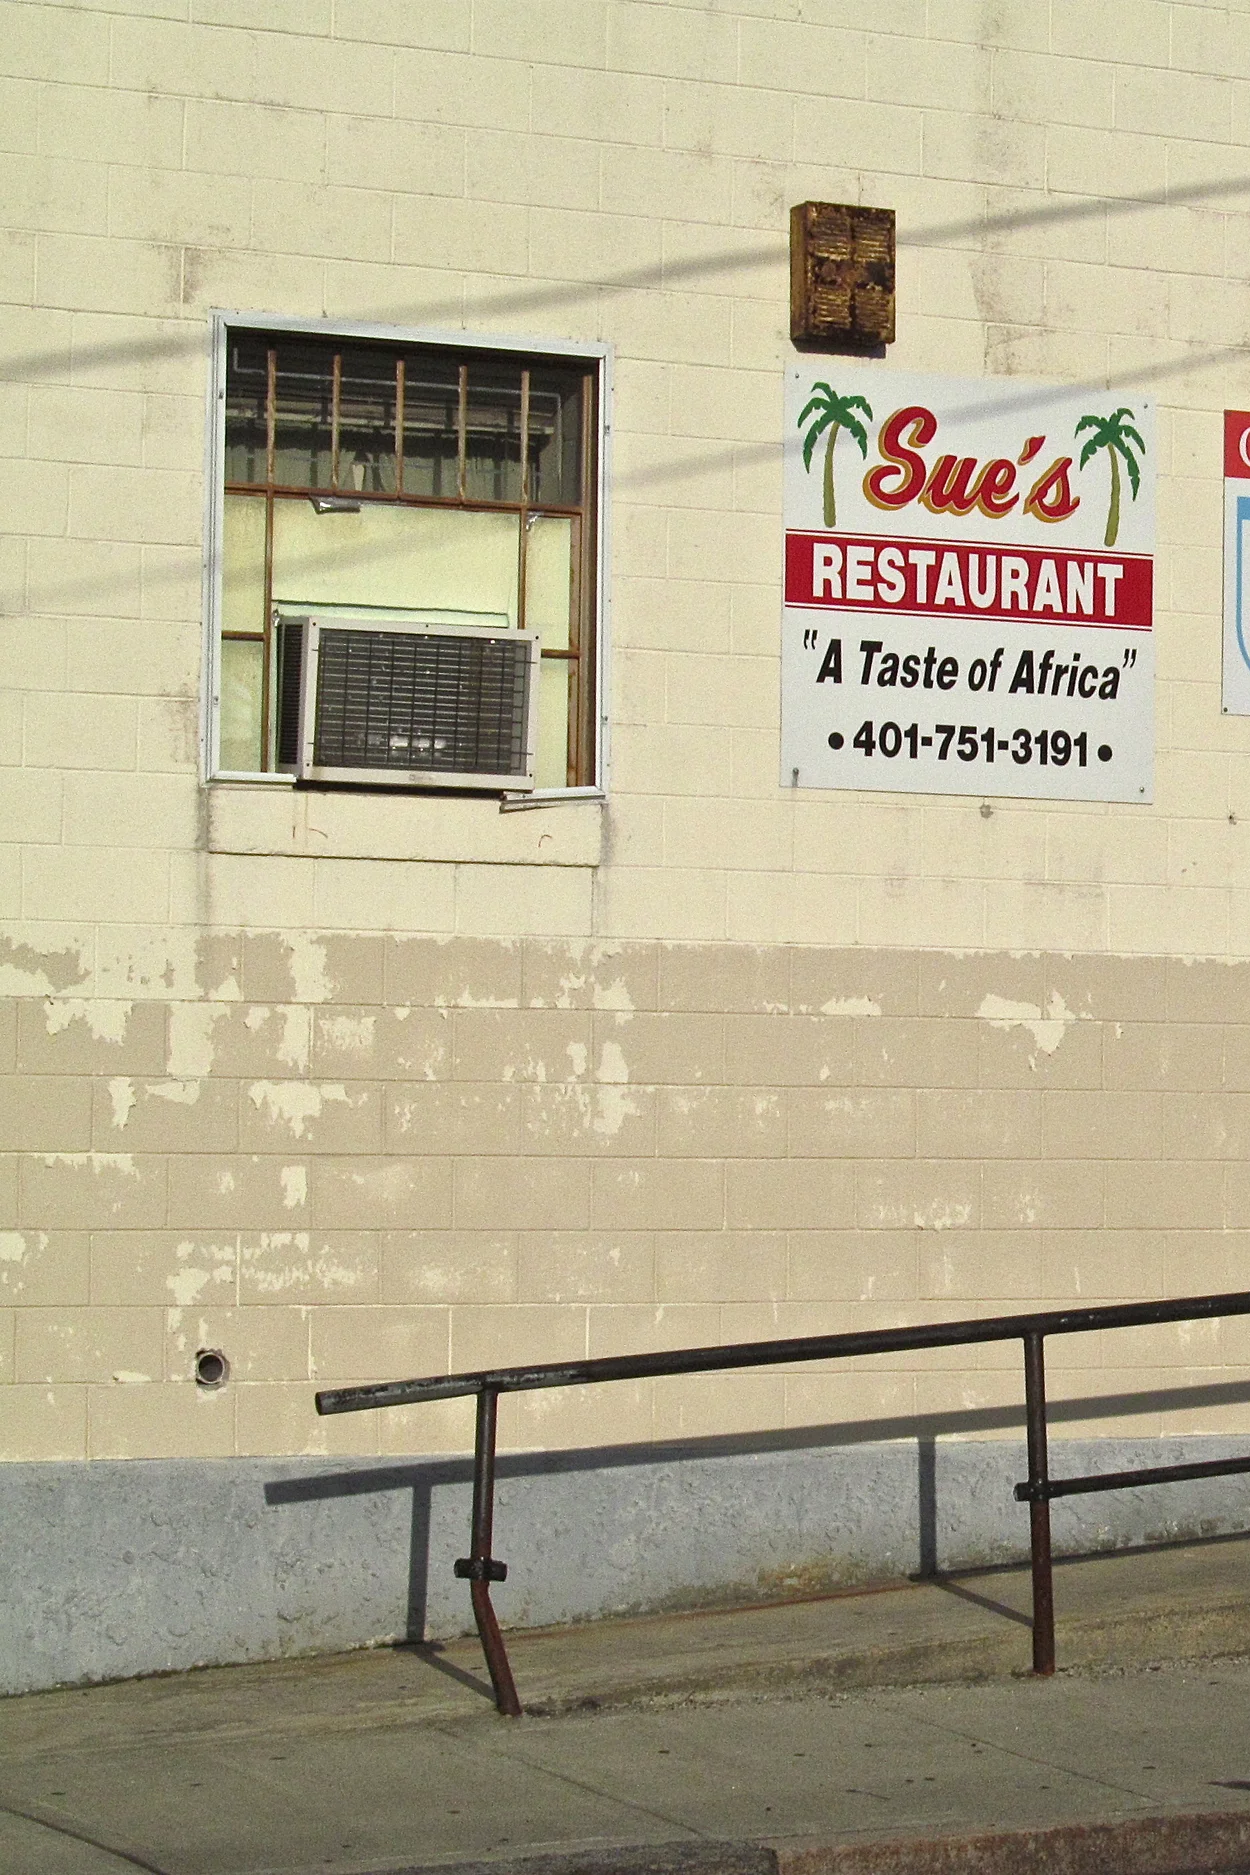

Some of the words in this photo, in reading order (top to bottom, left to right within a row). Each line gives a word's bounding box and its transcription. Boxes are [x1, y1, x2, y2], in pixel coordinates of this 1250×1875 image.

[862, 406, 1080, 523] Sue's
[812, 542, 1124, 617] RESTAURANT
[859, 639, 959, 692] Taste
[967, 647, 1005, 692] of
[852, 720, 1088, 767] 401-751-3191
